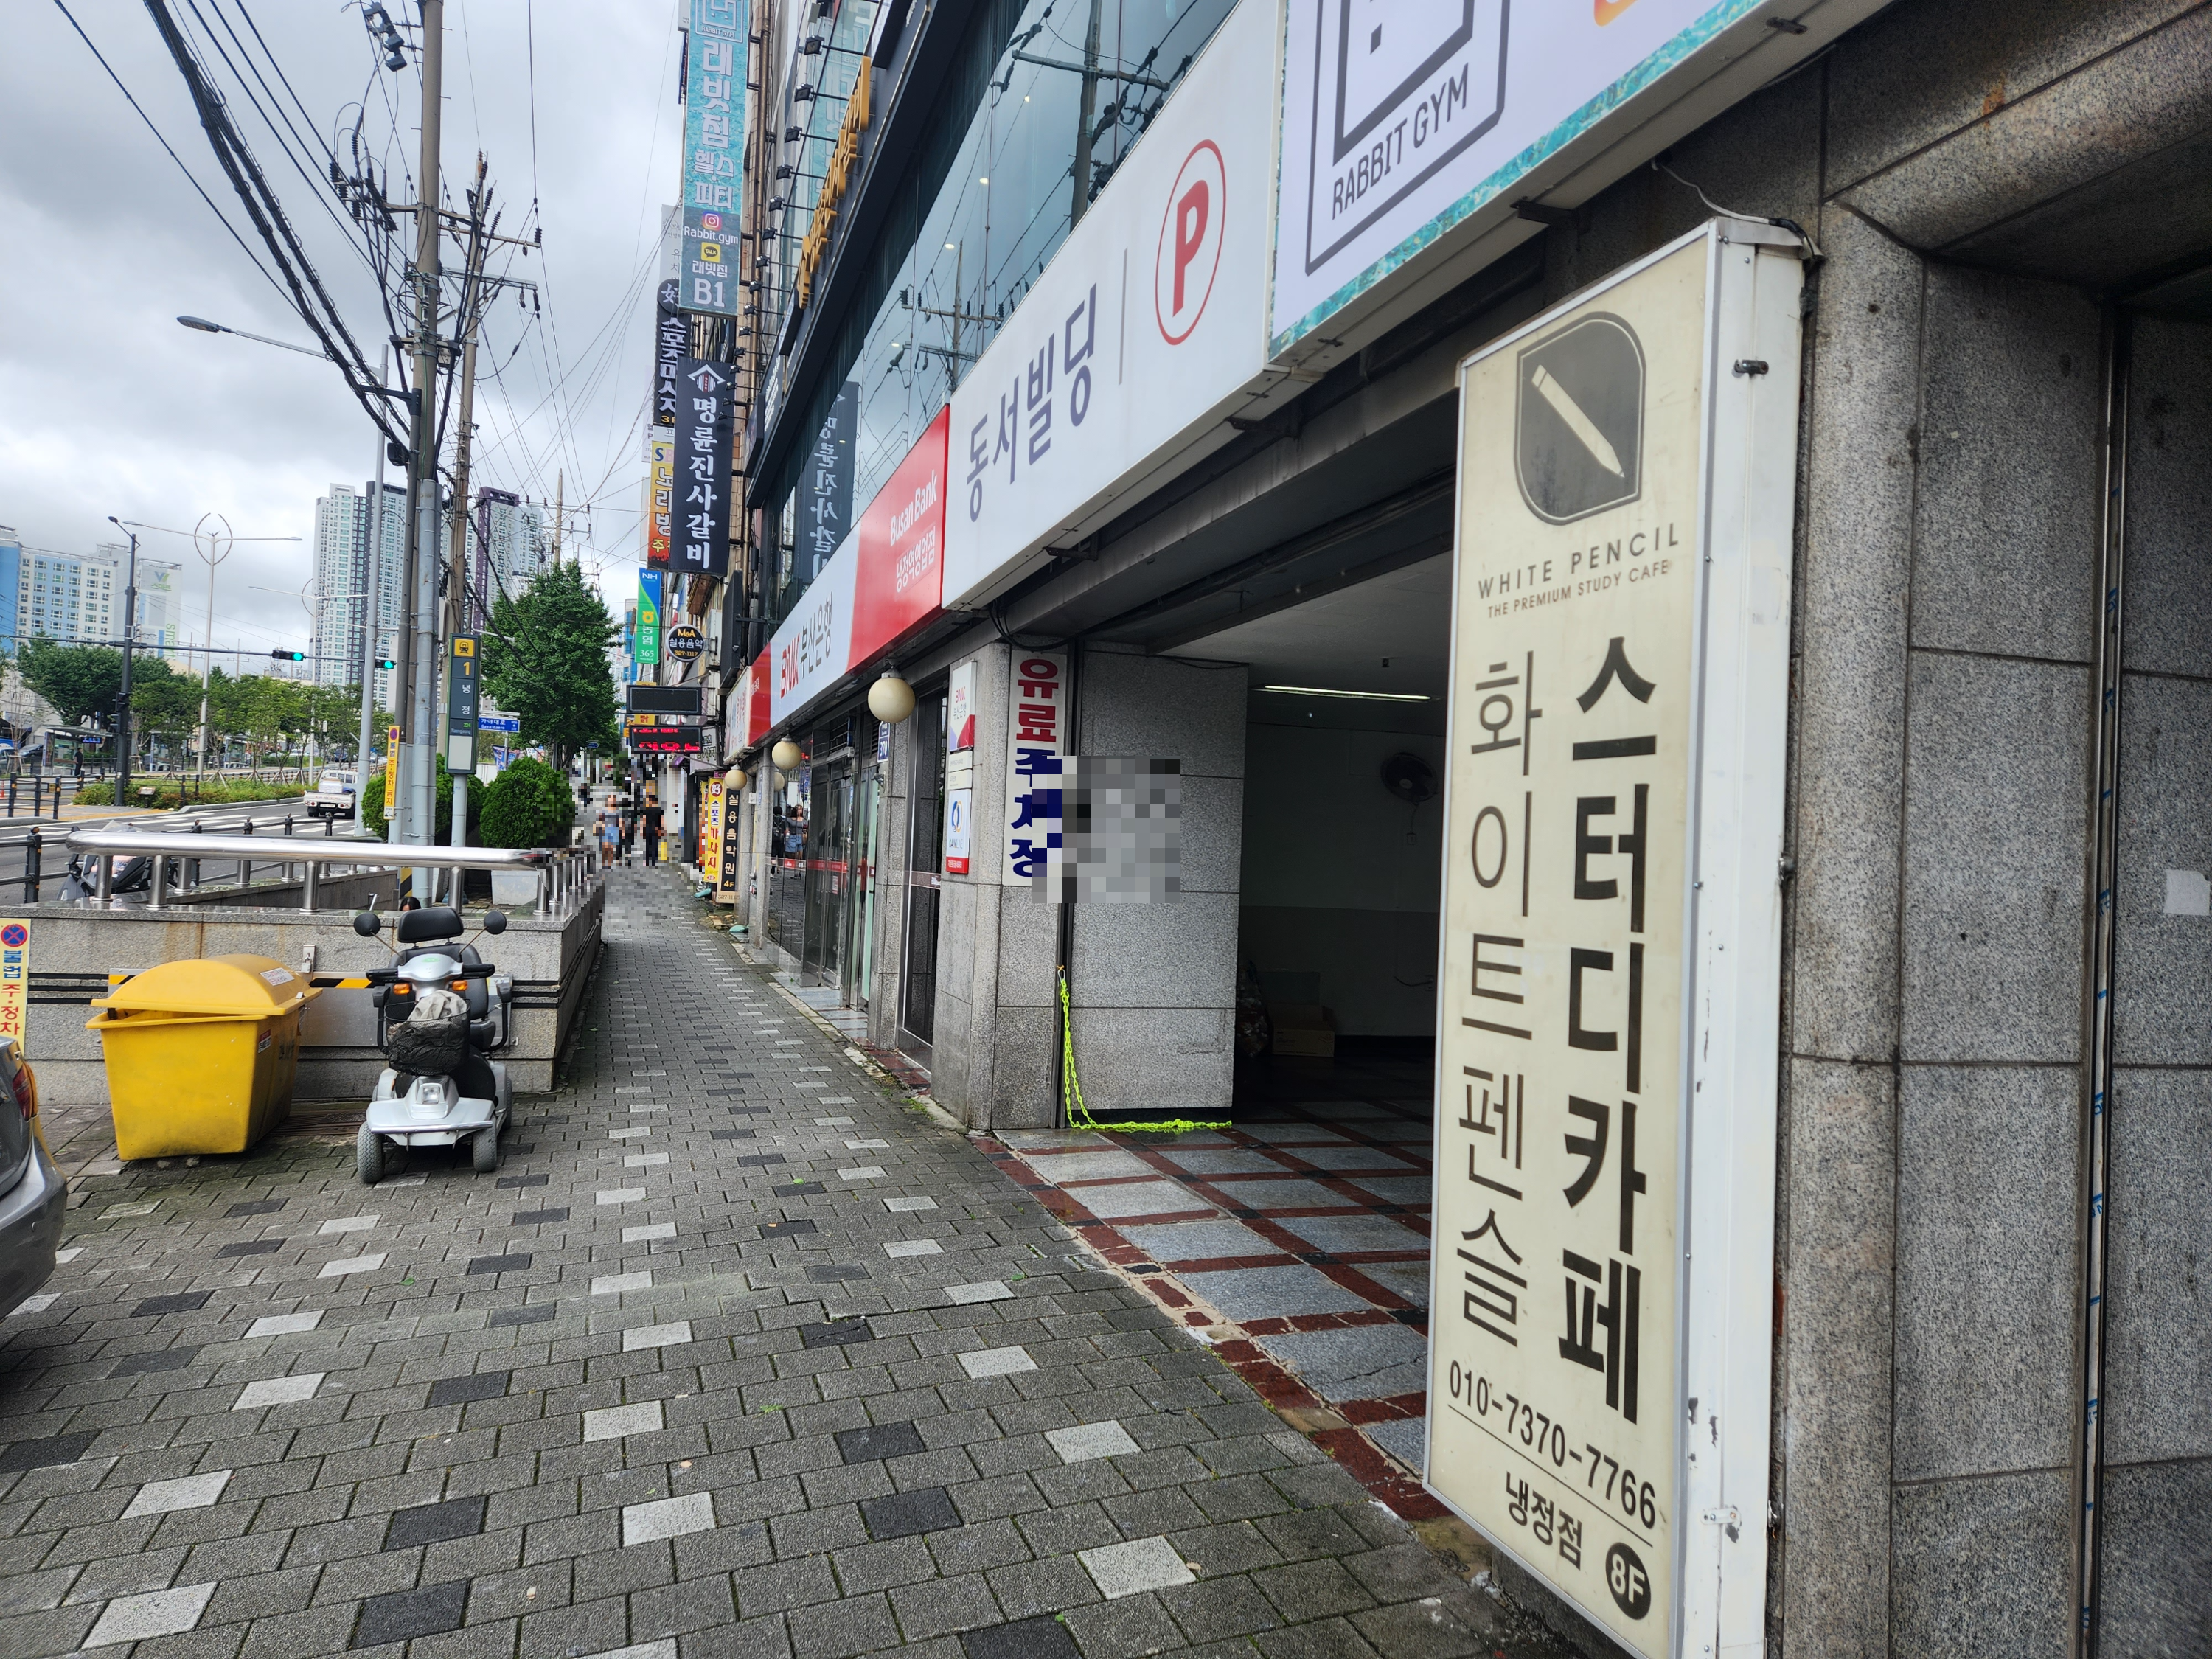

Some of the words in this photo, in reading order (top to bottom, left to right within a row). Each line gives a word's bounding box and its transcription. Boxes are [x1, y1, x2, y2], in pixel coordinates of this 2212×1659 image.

[702, 26, 722, 36] RABBIT
[723, 30, 735, 39] GYM
[702, 40, 733, 149] 래빗짐
[695, 149, 734, 178] 헬스
[1332, 117, 1408, 220] RABBIT
[1413, 62, 1469, 149] GYM
[695, 182, 733, 209] 피티
[684, 226, 739, 245] Rabbit.gym
[1172, 179, 1209, 317] P
[692, 260, 728, 278] 래빗짐
[694, 277, 725, 307] B1
[967, 282, 1096, 523] 동서빌딩
[686, 397, 717, 569] 명륜진사갈비
[890, 501, 914, 547] Busan
[914, 469, 938, 522] Bank
[897, 525, 936, 594] 냉정역영업점
[1478, 560, 1553, 599] WHITE
[1571, 522, 1679, 574] PENCIL
[1487, 601, 1509, 619] THE
[1513, 585, 1571, 613] PREMIUM
[1577, 571, 1621, 597] STUDY
[1629, 558, 1669, 583] CAFE
[639, 650, 655, 658] 365
[642, 624, 653, 645] 농협
[669, 637, 703, 649] 실용음악
[780, 632, 800, 699] BNK
[800, 591, 833, 679] 부산은행
[463, 661, 470, 676] 1
[953, 703, 967, 720] 부산은행
[955, 686, 966, 703] BNK
[880, 740, 888, 757] 370
[725, 794, 739, 874] 실용음악원
[723, 880, 734, 888] 4F
[4, 950, 23, 979] 불법
[1457, 650, 1543, 1347] 화이트펜슬
[1558, 636, 1658, 1425] 스터디카페
[1450, 1360, 1656, 1529] 010-7370-7766
[1506, 1471, 1582, 1571] 냉정점
[1610, 1554, 1645, 1604] 8F
